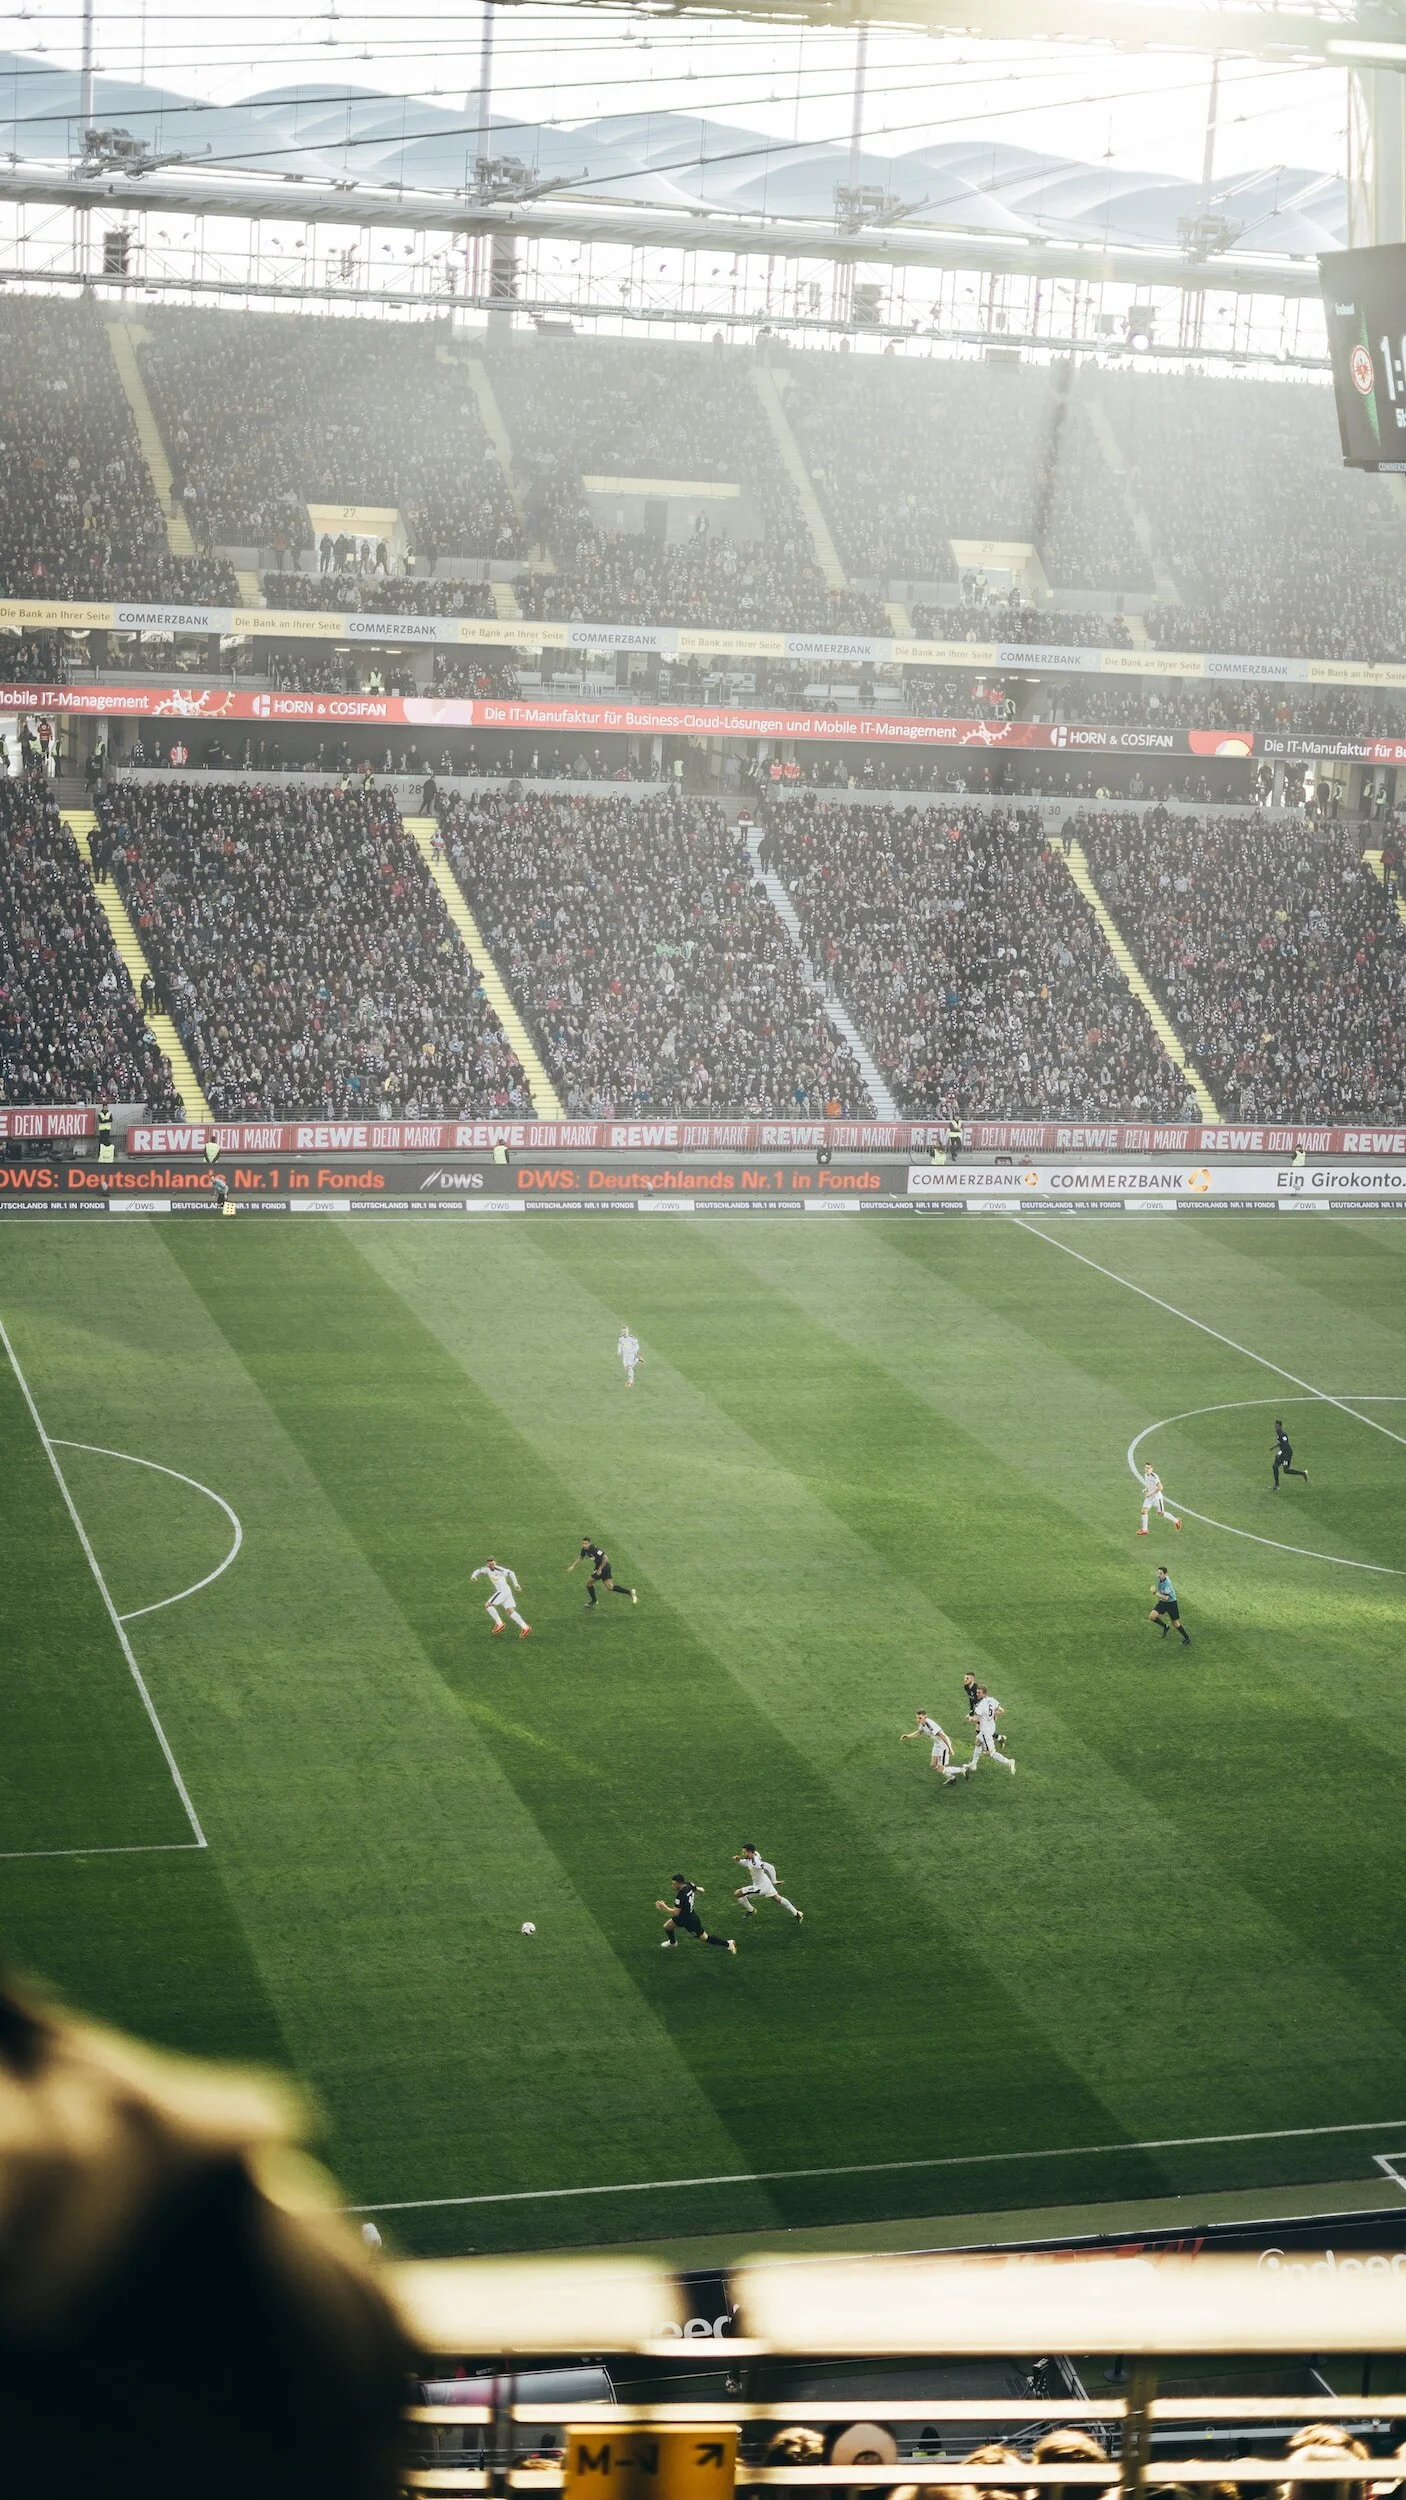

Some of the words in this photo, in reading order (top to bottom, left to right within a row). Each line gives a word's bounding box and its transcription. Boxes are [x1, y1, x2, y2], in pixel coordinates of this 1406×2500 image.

[1380, 336, 1406, 400] 1:
[343, 507, 356, 518] 27
[1, 608, 16, 617] Die
[20, 609, 42, 618] Bank
[46, 611, 57, 619] an
[60, 610, 83, 620] Ihrer
[87, 612, 110, 621] Seite
[119, 613, 209, 626] COMMERZBANK
[235, 617, 250, 627] Die
[253, 618, 276, 628] Bank
[279, 621, 290, 629] an
[293, 620, 315, 630] Ihrer
[318, 621, 341, 631] Seite
[349, 622, 436, 636] COMMERZBANK
[461, 627, 476, 637] Die
[479, 628, 501, 638] Bank
[518, 630, 538, 640] Ihrer
[542, 631, 564, 640] Seite
[572, 632, 657, 645] COMMERZBANK
[681, 637, 696, 646] Die
[698, 638, 720, 647] Bank
[736, 640, 757, 649] Ihrer
[760, 641, 781, 650] Seite
[789, 642, 871, 655] COMMERZBANK
[895, 647, 910, 656] Die
[912, 648, 933, 657] Bank
[936, 650, 946, 658] an
[949, 650, 969, 659] Ihrer
[972, 650, 993, 660] Seite
[1000, 652, 1081, 665] COMMERZBANK
[1105, 657, 1119, 667] Die
[1121, 658, 1142, 668] Bank
[1157, 659, 1177, 670] Ihrer
[1180, 660, 1201, 671] Seite
[1208, 662, 1288, 675] COMMERZBANK
[1311, 667, 1325, 677] Die
[1328, 668, 1349, 678] Bank
[1350, 671, 1361, 679] an
[1363, 670, 1383, 680] Ihrer
[1386, 671, 1406, 681] Seite
[0, 690, 37, 705] obile
[41, 692, 149, 710] IT-Management
[274, 700, 314, 713] HORN
[317, 703, 326, 713] &
[330, 702, 387, 716] COSIFAN
[485, 707, 506, 721] Die
[510, 708, 601, 724] IT-Manufaktur
[603, 710, 622, 724] für
[626, 712, 783, 732] Business-Cloud-Lösungen
[787, 718, 810, 731] und
[814, 720, 857, 733] Mobile
[860, 721, 957, 738] IT-Management
[1070, 731, 1107, 745] HORN
[1109, 735, 1118, 745] &
[1121, 733, 1174, 747] COSIFAN
[1264, 739, 1284, 752] Die
[1287, 740, 1372, 757] IT-Manufaktur
[1374, 743, 1393, 757] für
[409, 784, 421, 794] 28
[1049, 805, 1061, 815] 30
[14, 1114, 43, 1136] DEIN
[48, 1113, 89, 1135] MARKT
[134, 1128, 205, 1150] REWE
[212, 1128, 239, 1149] DEIN
[244, 1128, 283, 1149] MARKT
[297, 1127, 367, 1148] REWE
[372, 1127, 399, 1147] DEIN
[404, 1127, 443, 1147] MARKT
[456, 1126, 524, 1146] REWE
[530, 1126, 556, 1146] DEIN
[561, 1126, 598, 1146] MARKT
[611, 1126, 678, 1147] REWE
[684, 1126, 709, 1146] DEIN
[713, 1126, 750, 1146] MARKT
[762, 1126, 825, 1146] REWE
[833, 1127, 857, 1146] DEIN
[861, 1127, 898, 1146] MARKT
[981, 1127, 1006, 1146] DEIN
[1010, 1127, 1046, 1147] MARKT
[1056, 1129, 1119, 1148] REWE
[1125, 1129, 1150, 1149] DEIN
[1154, 1130, 1189, 1150] MARKT
[1200, 1130, 1264, 1150] REWE
[1268, 1131, 1293, 1151] DEIN
[1297, 1132, 1332, 1151] MARKT
[1343, 1133, 1405, 1153] REWE
[234, 1169, 279, 1188] Nr.1
[289, 1169, 309, 1188] in
[317, 1169, 385, 1188] Fonds
[517, 1170, 580, 1189] DWS:
[588, 1170, 735, 1189] Deutschlands
[741, 1171, 784, 1189] Nr.1
[792, 1171, 811, 1189] in
[818, 1171, 881, 1189] Fonds
[912, 1174, 1022, 1186] COMMERZBANK
[1050, 1174, 1183, 1188] COMMERZBANK
[1277, 1172, 1304, 1187] Ein
[69, 1202, 77, 1210] IN
[80, 1202, 105, 1210] FONDS
[988, 1704, 994, 1717] 6
